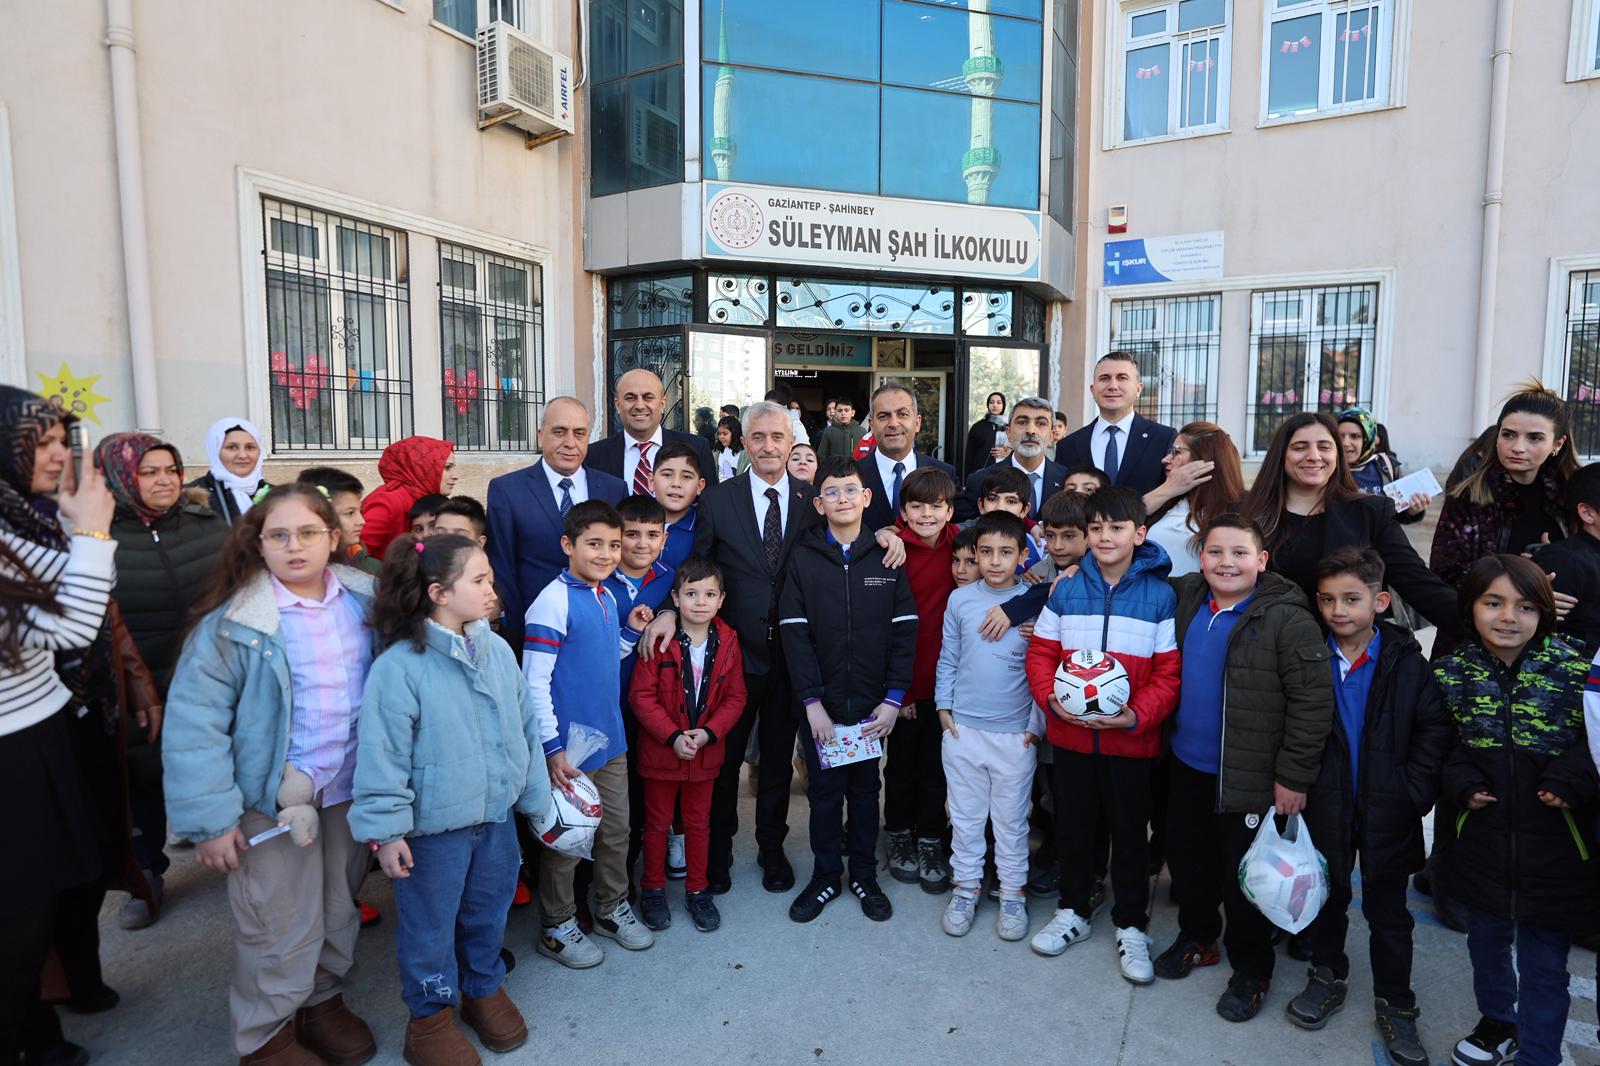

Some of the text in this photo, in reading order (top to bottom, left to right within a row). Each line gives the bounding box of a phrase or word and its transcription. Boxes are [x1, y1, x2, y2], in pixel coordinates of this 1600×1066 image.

[768, 197, 821, 211] GAZİANTEP
[829, 203, 875, 216] ŞAHİNBEY
[768, 216, 881, 254] SÜLEYMAN
[888, 229, 927, 262] ŞAH
[934, 227, 1028, 265] İLKOKULU
[786, 342, 854, 357] GELDİNİZ
